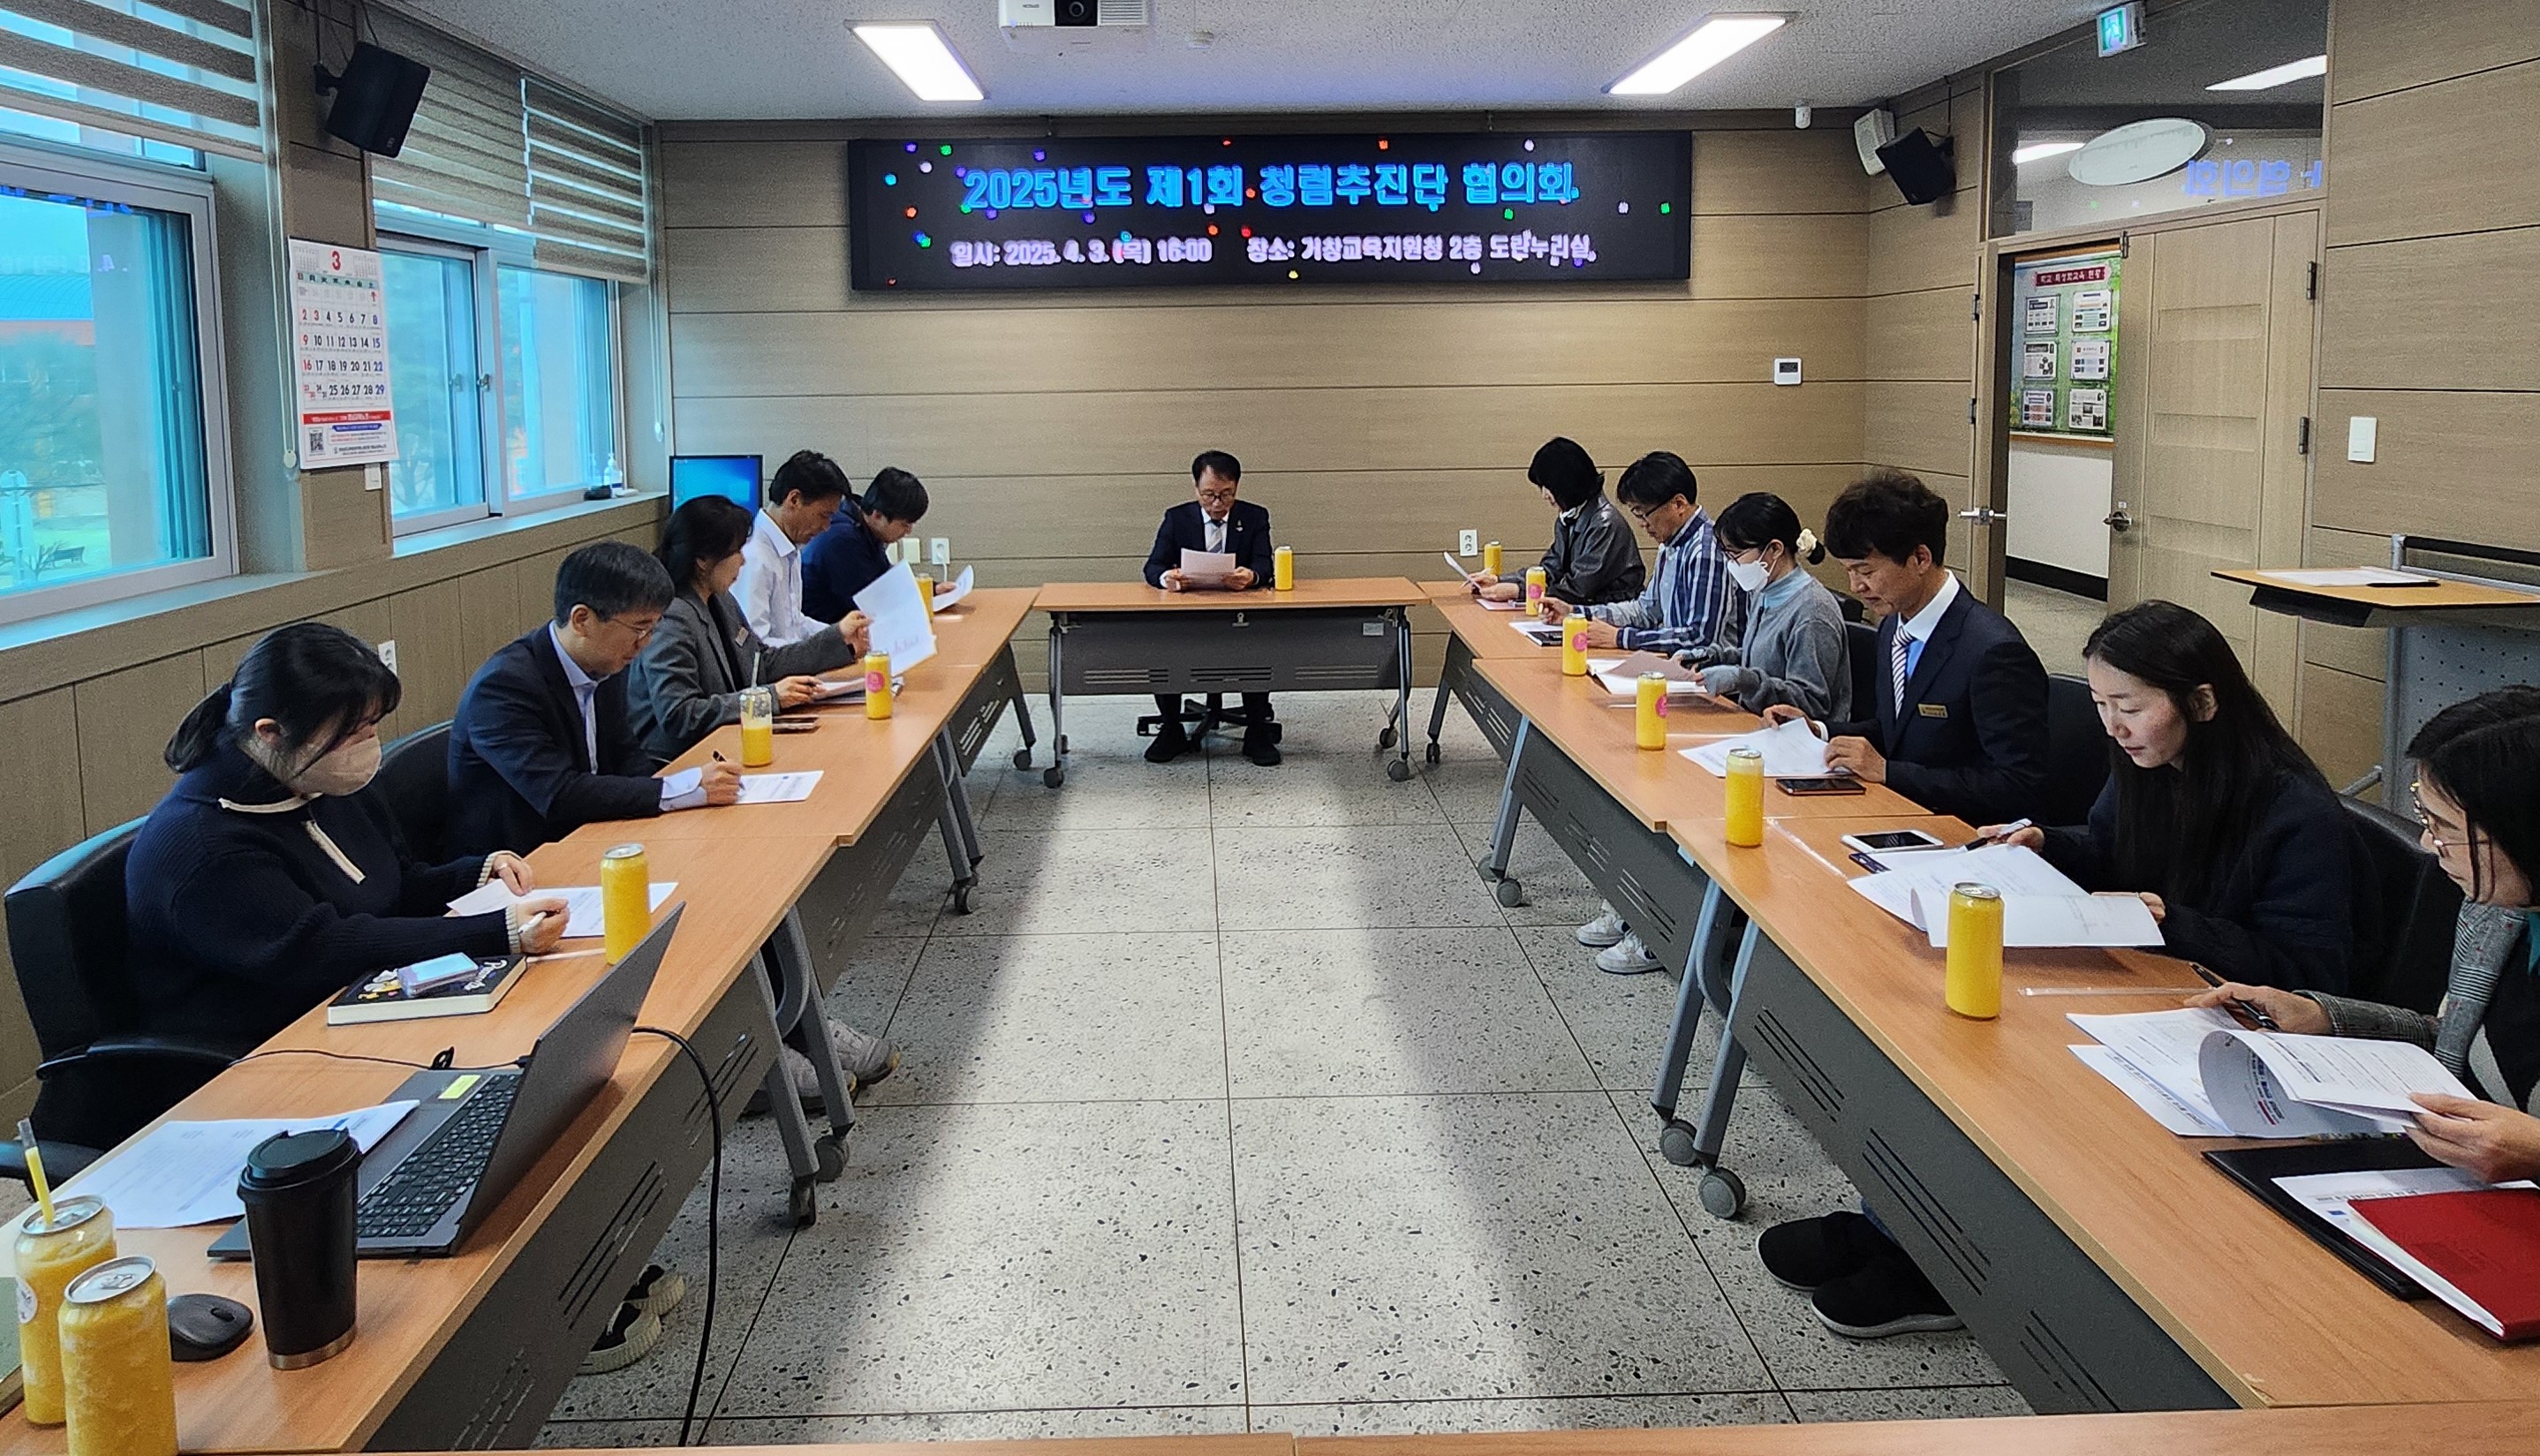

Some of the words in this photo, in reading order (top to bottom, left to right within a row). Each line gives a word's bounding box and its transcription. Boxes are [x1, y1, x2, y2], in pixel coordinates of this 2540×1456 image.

[964, 166, 1133, 209] 2025년도
[1146, 166, 1244, 207] 제1회
[1259, 163, 1448, 207] 청렴추진단
[1463, 162, 1574, 204] 협의회
[949, 239, 1001, 268] 일시:
[1003, 239, 1062, 266] 2025.
[1063, 238, 1086, 263] 4.
[1087, 238, 1111, 264] 3.
[1112, 238, 1153, 264] (목)
[1156, 237, 1213, 263] 16:00
[1246, 236, 1295, 262] 장소:
[1301, 235, 1443, 261] 거창교육지원청
[1448, 234, 1483, 260] 2층
[331, 250, 341, 270] 3
[302, 309, 307, 321] 2
[314, 310, 320, 321] 3
[326, 311, 331, 322] 4
[337, 312, 344, 323] 5
[349, 313, 355, 324] 6
[360, 313, 366, 324] 7
[373, 314, 378, 326] 8
[303, 334, 308, 345] 9
[314, 335, 322, 346] 10
[327, 336, 334, 347] 11
[338, 336, 345, 348] 12
[349, 336, 358, 348] 13
[360, 337, 369, 348] 14
[373, 337, 381, 349] 15
[303, 359, 312, 371] 16
[315, 359, 323, 371] 17
[328, 360, 336, 371] 18
[339, 360, 347, 371] 19
[351, 360, 359, 372] 20
[362, 361, 371, 372] 21
[374, 361, 383, 372] 22
[329, 384, 338, 396] 25
[341, 384, 350, 396] 26
[352, 384, 360, 396] 27
[364, 384, 374, 396] 28
[375, 384, 384, 396] 29
